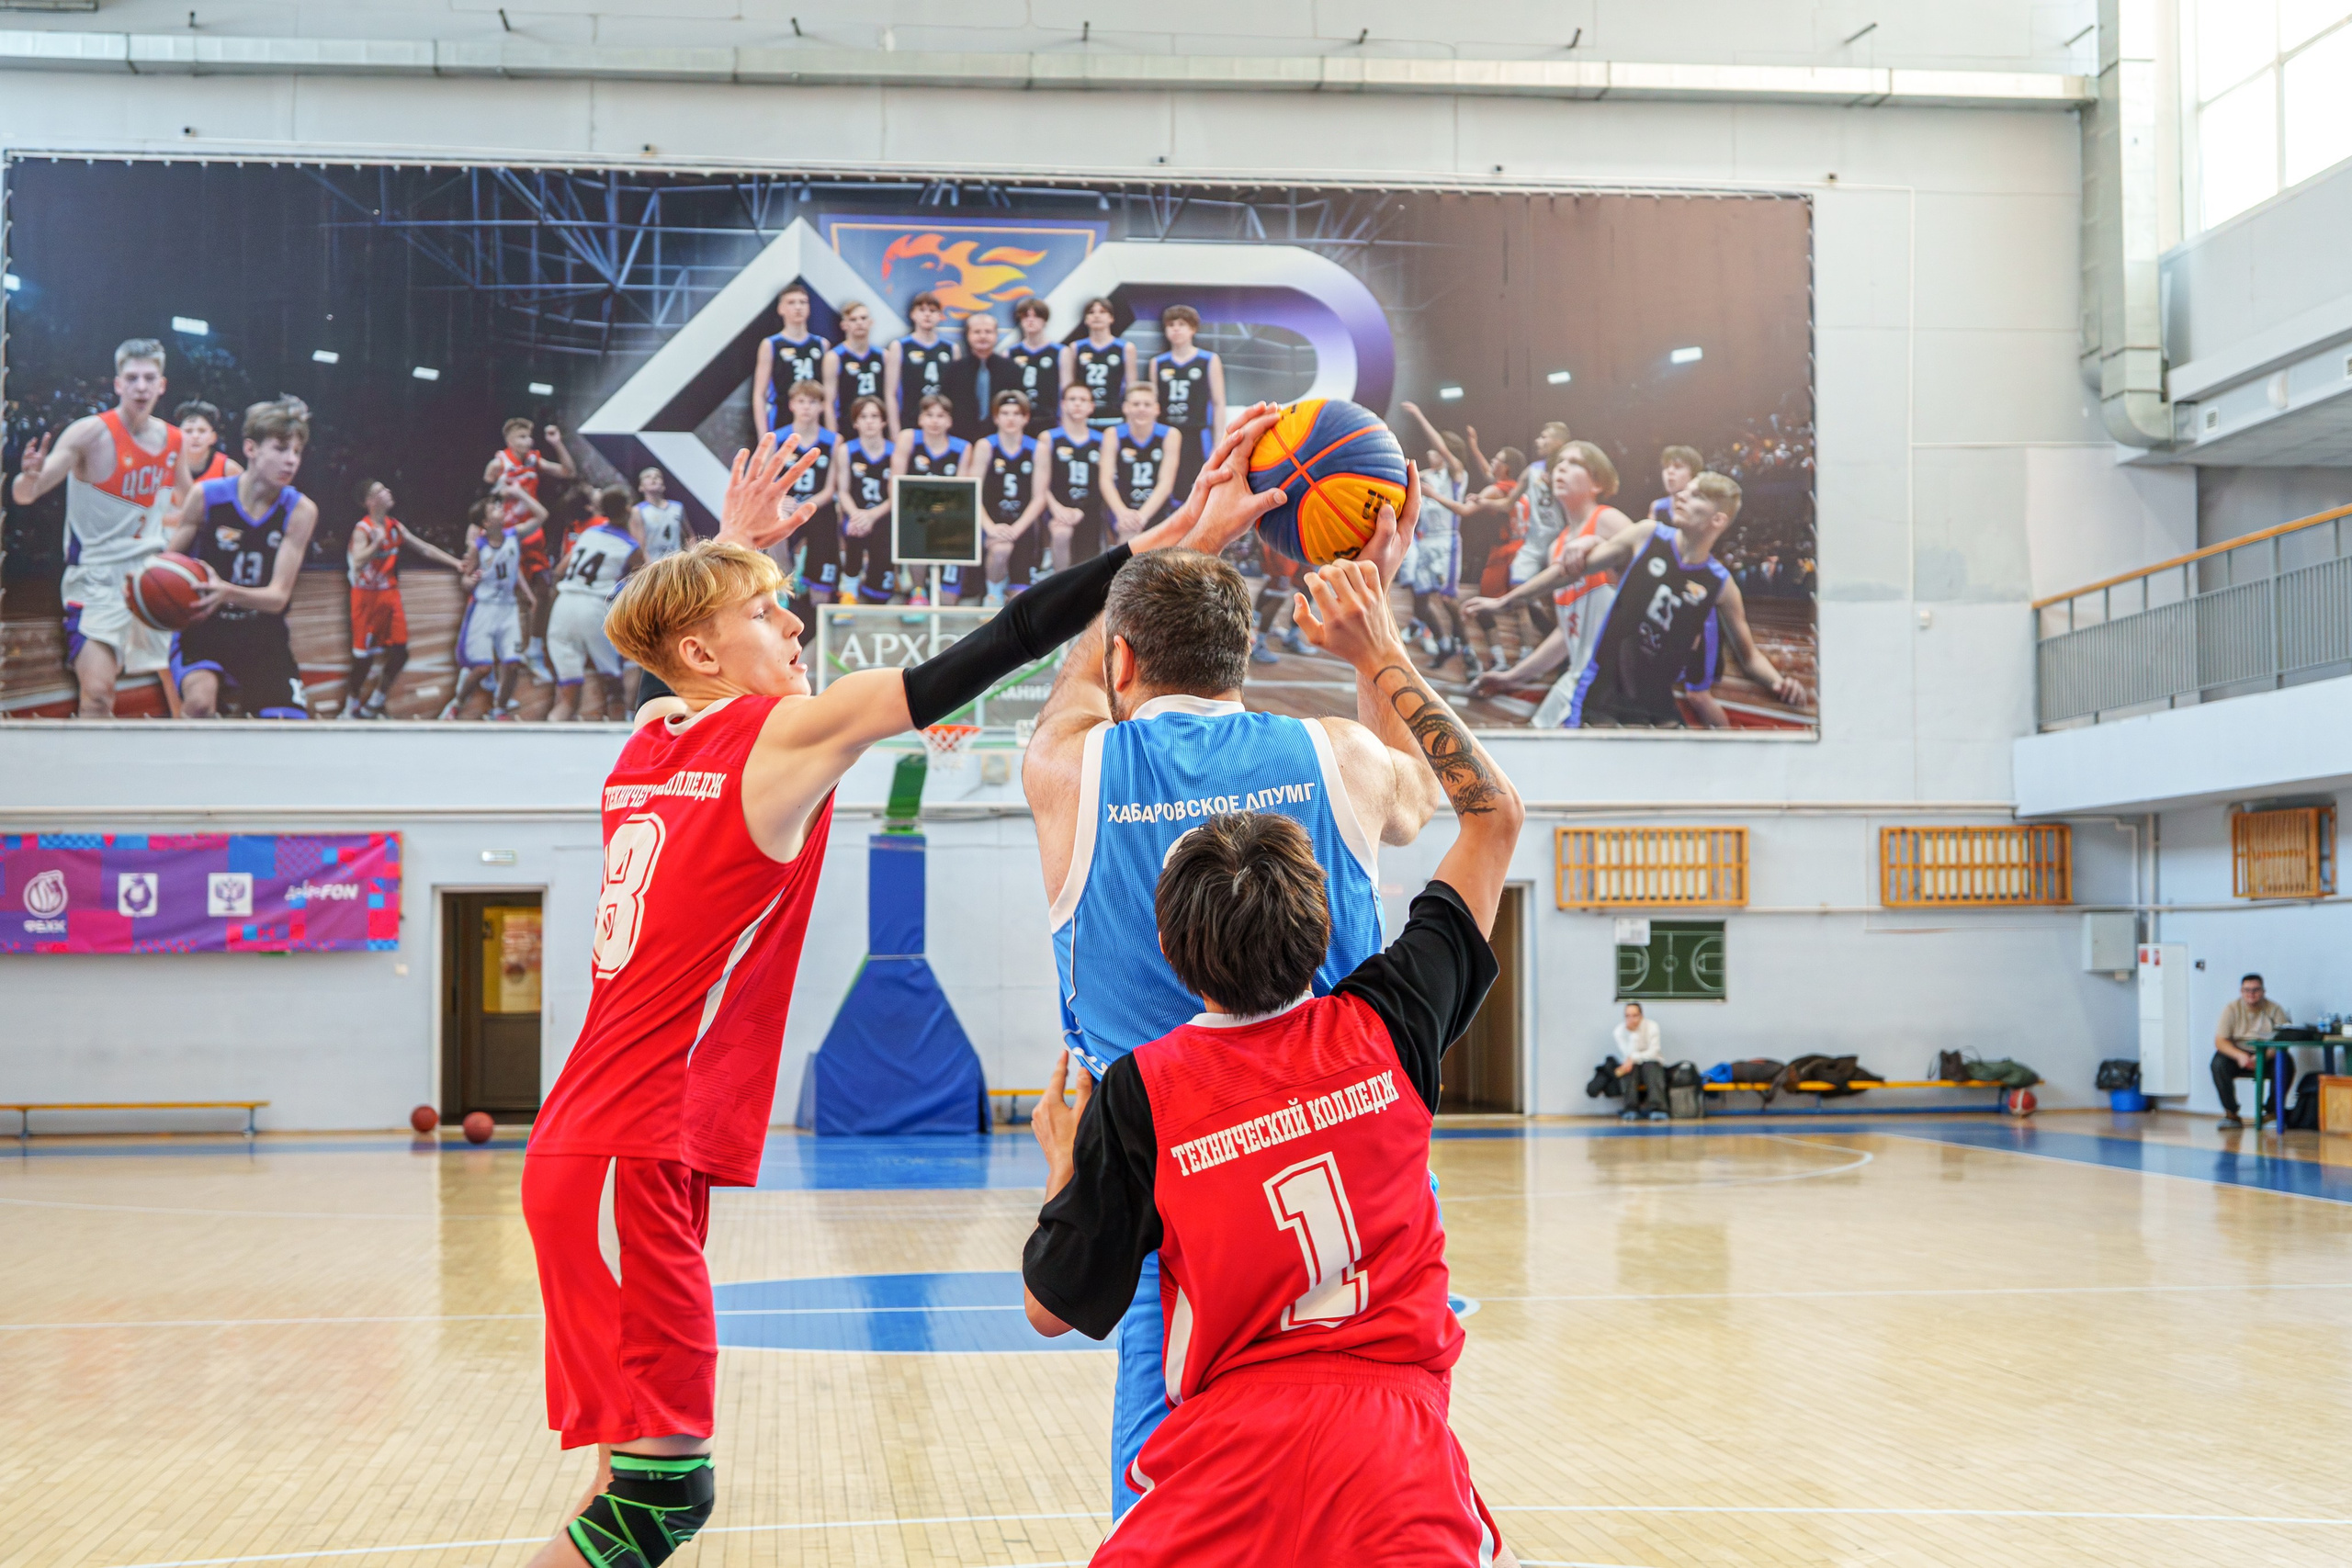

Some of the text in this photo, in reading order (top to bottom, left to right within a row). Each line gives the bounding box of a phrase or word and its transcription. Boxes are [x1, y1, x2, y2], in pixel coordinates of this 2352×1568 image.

[856, 372, 876, 396] 23
[924, 361, 939, 383] 4
[1086, 364, 1108, 386] 22
[1167, 379, 1190, 401] 15
[1003, 473, 1018, 497] 5
[1131, 462, 1153, 487] 12
[862, 477, 882, 501] 21
[232, 551, 264, 586] 13
[1107, 795, 1241, 824] ХАБАРОВСКОЕ
[593, 812, 666, 980] 8
[1170, 1069, 1400, 1177] ТЕХНИЧЕСКИЙ КОЛЛЕДЖ
[1262, 1151, 1369, 1332] 1
